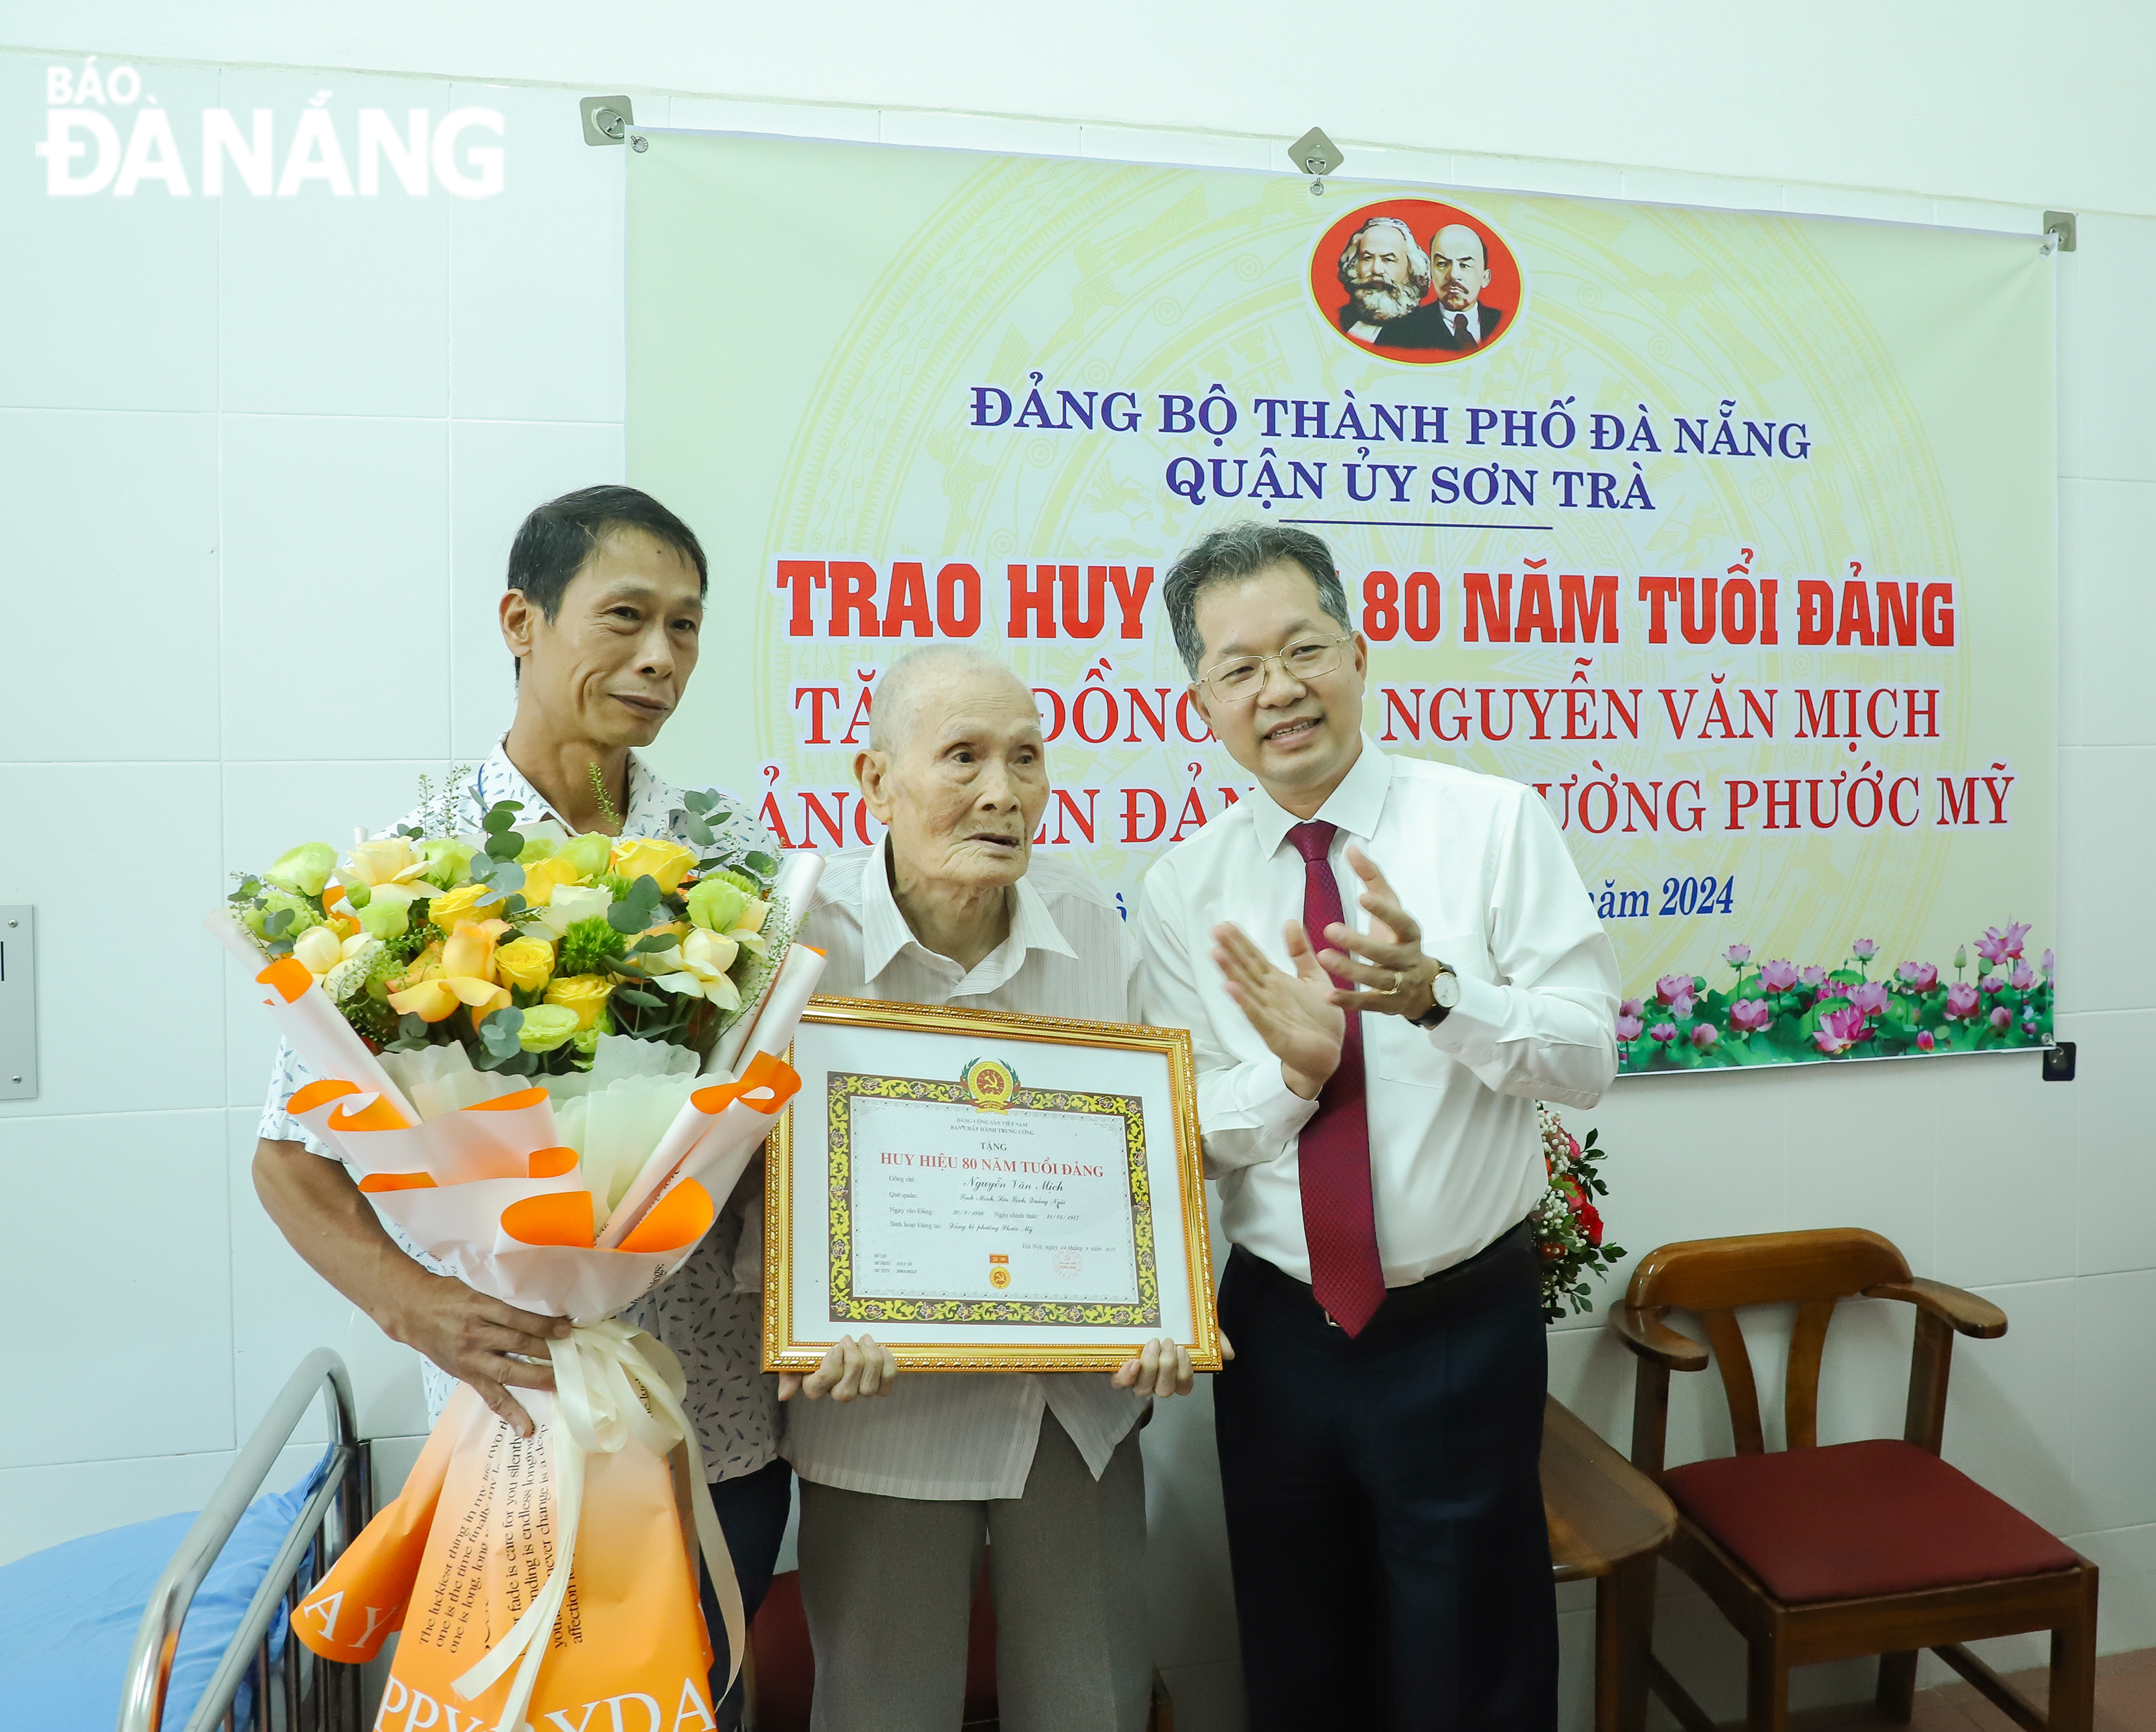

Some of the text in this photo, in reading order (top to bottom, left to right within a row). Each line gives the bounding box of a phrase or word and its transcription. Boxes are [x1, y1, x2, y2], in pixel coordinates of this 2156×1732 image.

[971, 371, 1811, 460] ĐẢNG BỘ THÀNH PHỐ ĐÀ NẴNG
[1166, 446, 1656, 510] QUẬN ỦY SƠN TRÀ
[777, 548, 1955, 646] TRAO HUY 80 NĂM TUỔI ĐẢNG
[1381, 657, 1643, 742] NGUYỄN
[1658, 674, 1778, 740] VĂN
[1795, 689, 1939, 752] MỊCH
[1532, 760, 1706, 834] ƯỜNG
[1725, 761, 1918, 830] PHƯỚC
[1937, 763, 2014, 825] MỸ
[1589, 875, 1734, 919] ăm 2024
[980, 1141, 1007, 1152] TẶNG
[881, 1152, 1103, 1178] HUY HIỆU 80 NĂM TUỔI ĐẢNG
[963, 1176, 1006, 1192] Nguyễn
[1012, 1179, 1032, 1191] Văn
[1035, 1180, 1064, 1194] Mịch
[507, 1434, 525, 1478] silently
[541, 1460, 547, 1469] a
[539, 1472, 549, 1484] is
[507, 1482, 517, 1506] you
[503, 1511, 514, 1528] for
[518, 1489, 533, 1540] endless
[537, 1486, 551, 1535] change
[458, 1546, 472, 1577] time
[505, 1531, 517, 1561] care
[523, 1544, 535, 1555] is
[420, 1618, 436, 1644] The
[428, 1563, 453, 1614] luckiest
[449, 1525, 470, 1559] thing
[463, 1510, 476, 1523] in
[506, 1565, 518, 1577] is
[448, 1579, 462, 1601] the
[506, 1580, 522, 1612] fade
[444, 1606, 455, 1617] is
[566, 1584, 583, 1644] affection
[436, 1620, 450, 1647] one
[450, 1626, 465, 1653] one
[458, 1612, 469, 1623] is
